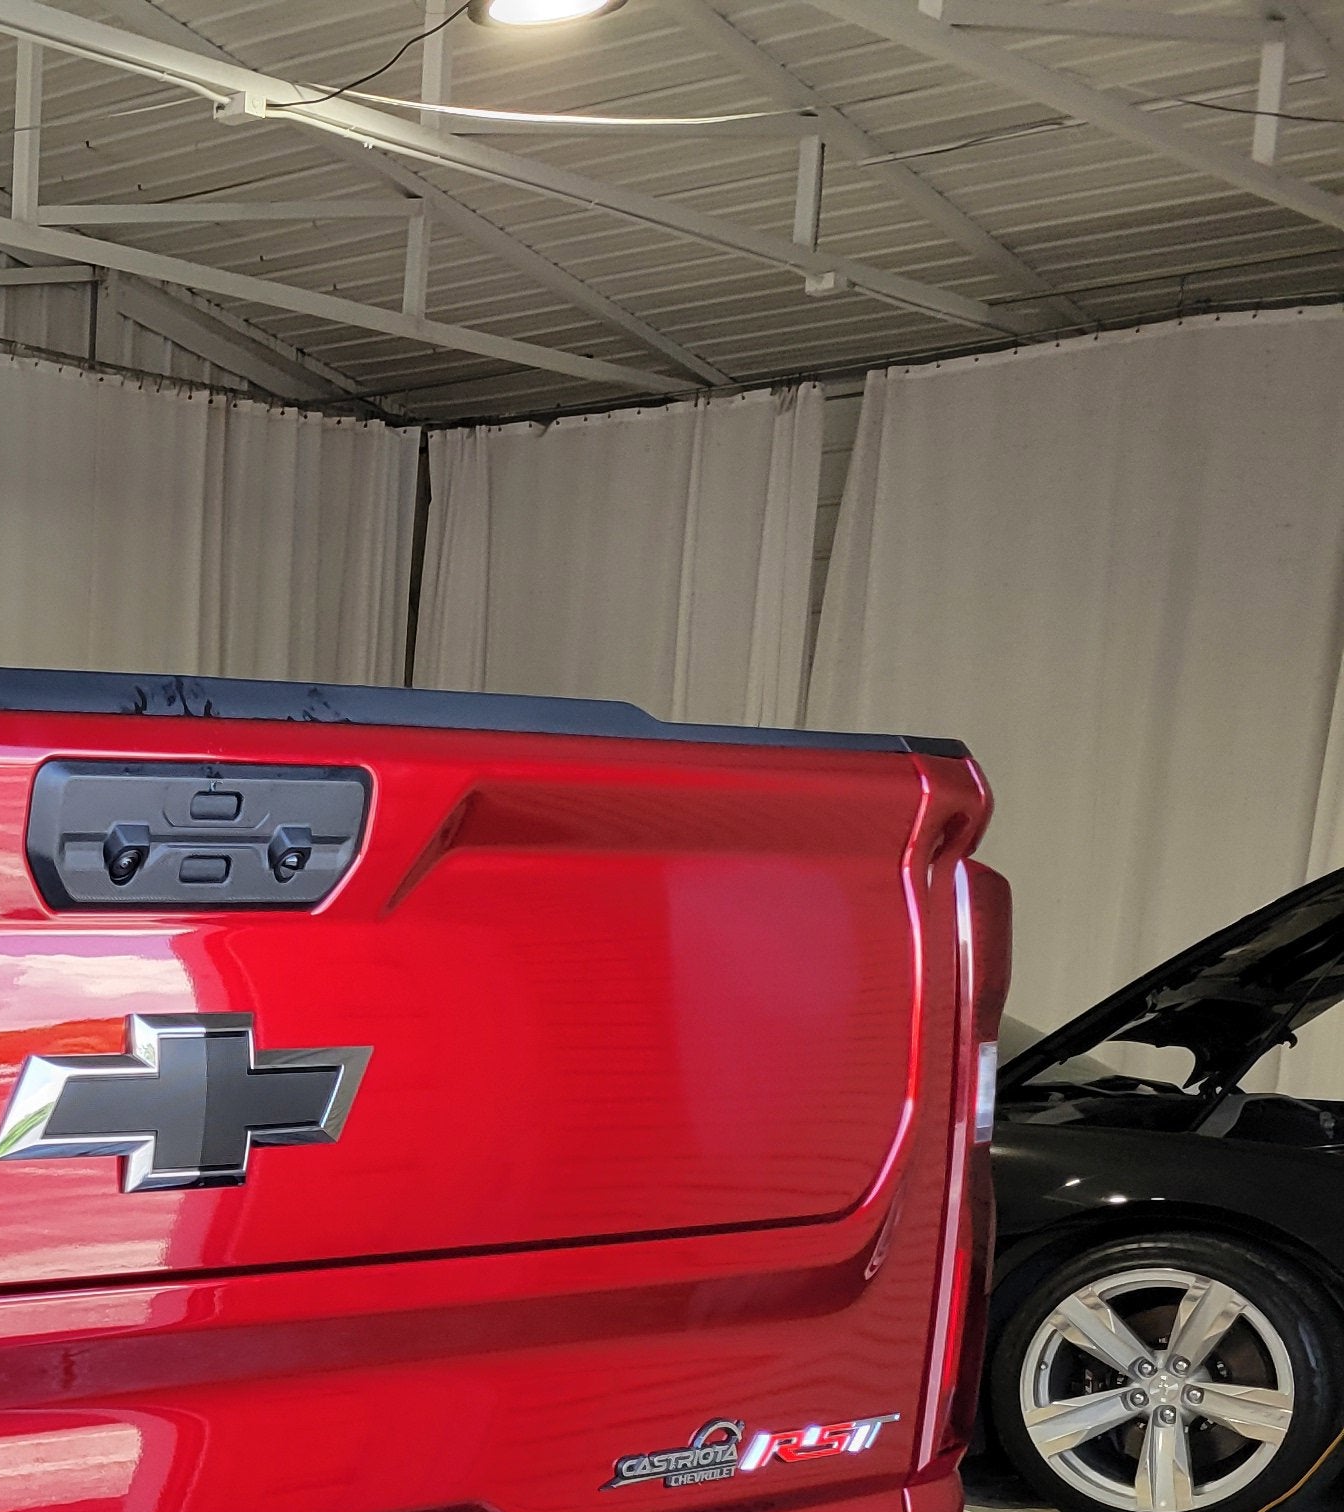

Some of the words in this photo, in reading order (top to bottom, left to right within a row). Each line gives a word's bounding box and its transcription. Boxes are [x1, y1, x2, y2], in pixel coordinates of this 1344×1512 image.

[740, 1412, 900, 1471] RST
[620, 1444, 738, 1478] CASTRIOTA
[671, 1467, 736, 1487] CHEVROLET
